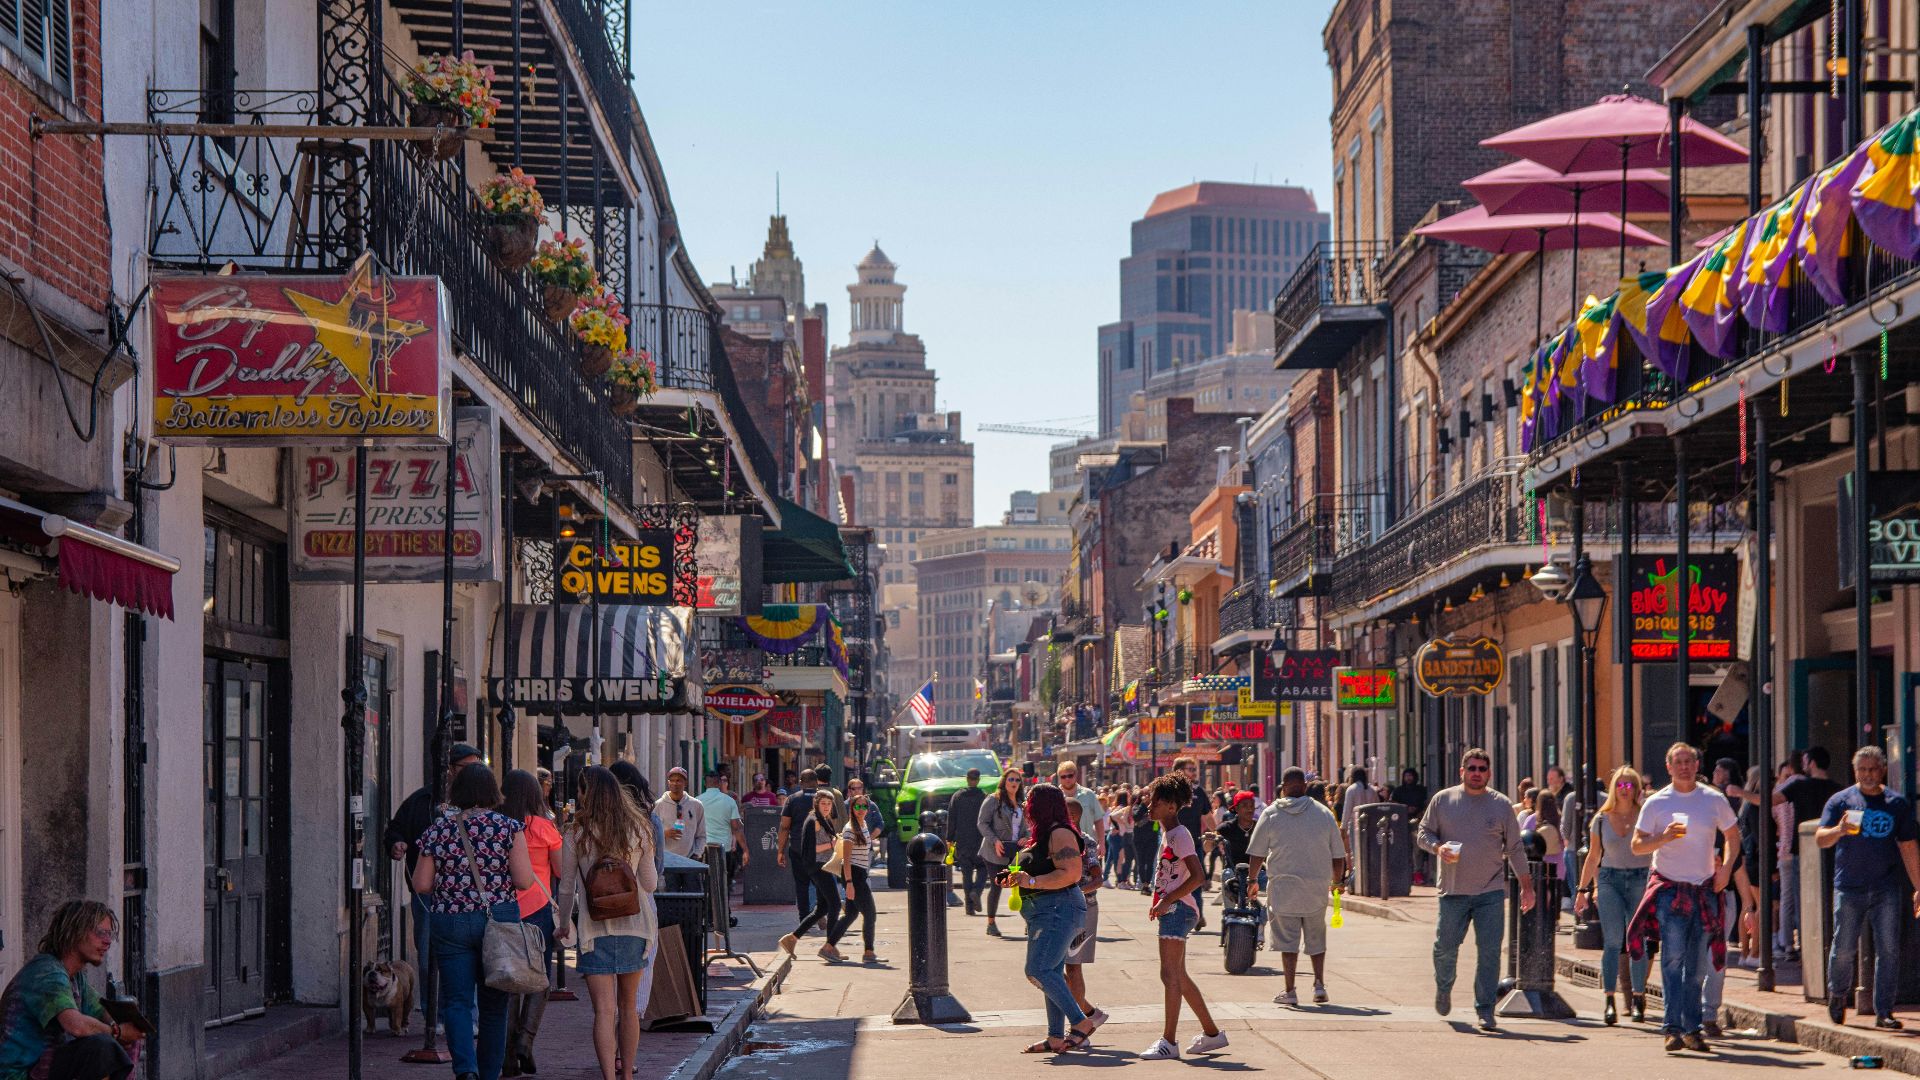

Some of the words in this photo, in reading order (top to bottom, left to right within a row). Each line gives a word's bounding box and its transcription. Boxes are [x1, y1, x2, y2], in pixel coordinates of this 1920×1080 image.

[162, 341, 352, 406] Daddy's
[164, 401, 321, 429] Bottomless
[326, 401, 434, 433] Topless
[305, 453, 481, 501] PIZZA
[392, 532, 424, 553] THE
[428, 532, 475, 553] SLCE
[561, 570, 668, 596] OWENS
[1631, 583, 1669, 614] BIG
[1263, 668, 1334, 679] SUTR
[1424, 658, 1499, 677] BANDSTAND
[496, 679, 573, 702] CHRIS
[583, 679, 674, 701] OWENS
[704, 696, 775, 707] DIXIELAND
[1271, 686, 1333, 696] CABARE
